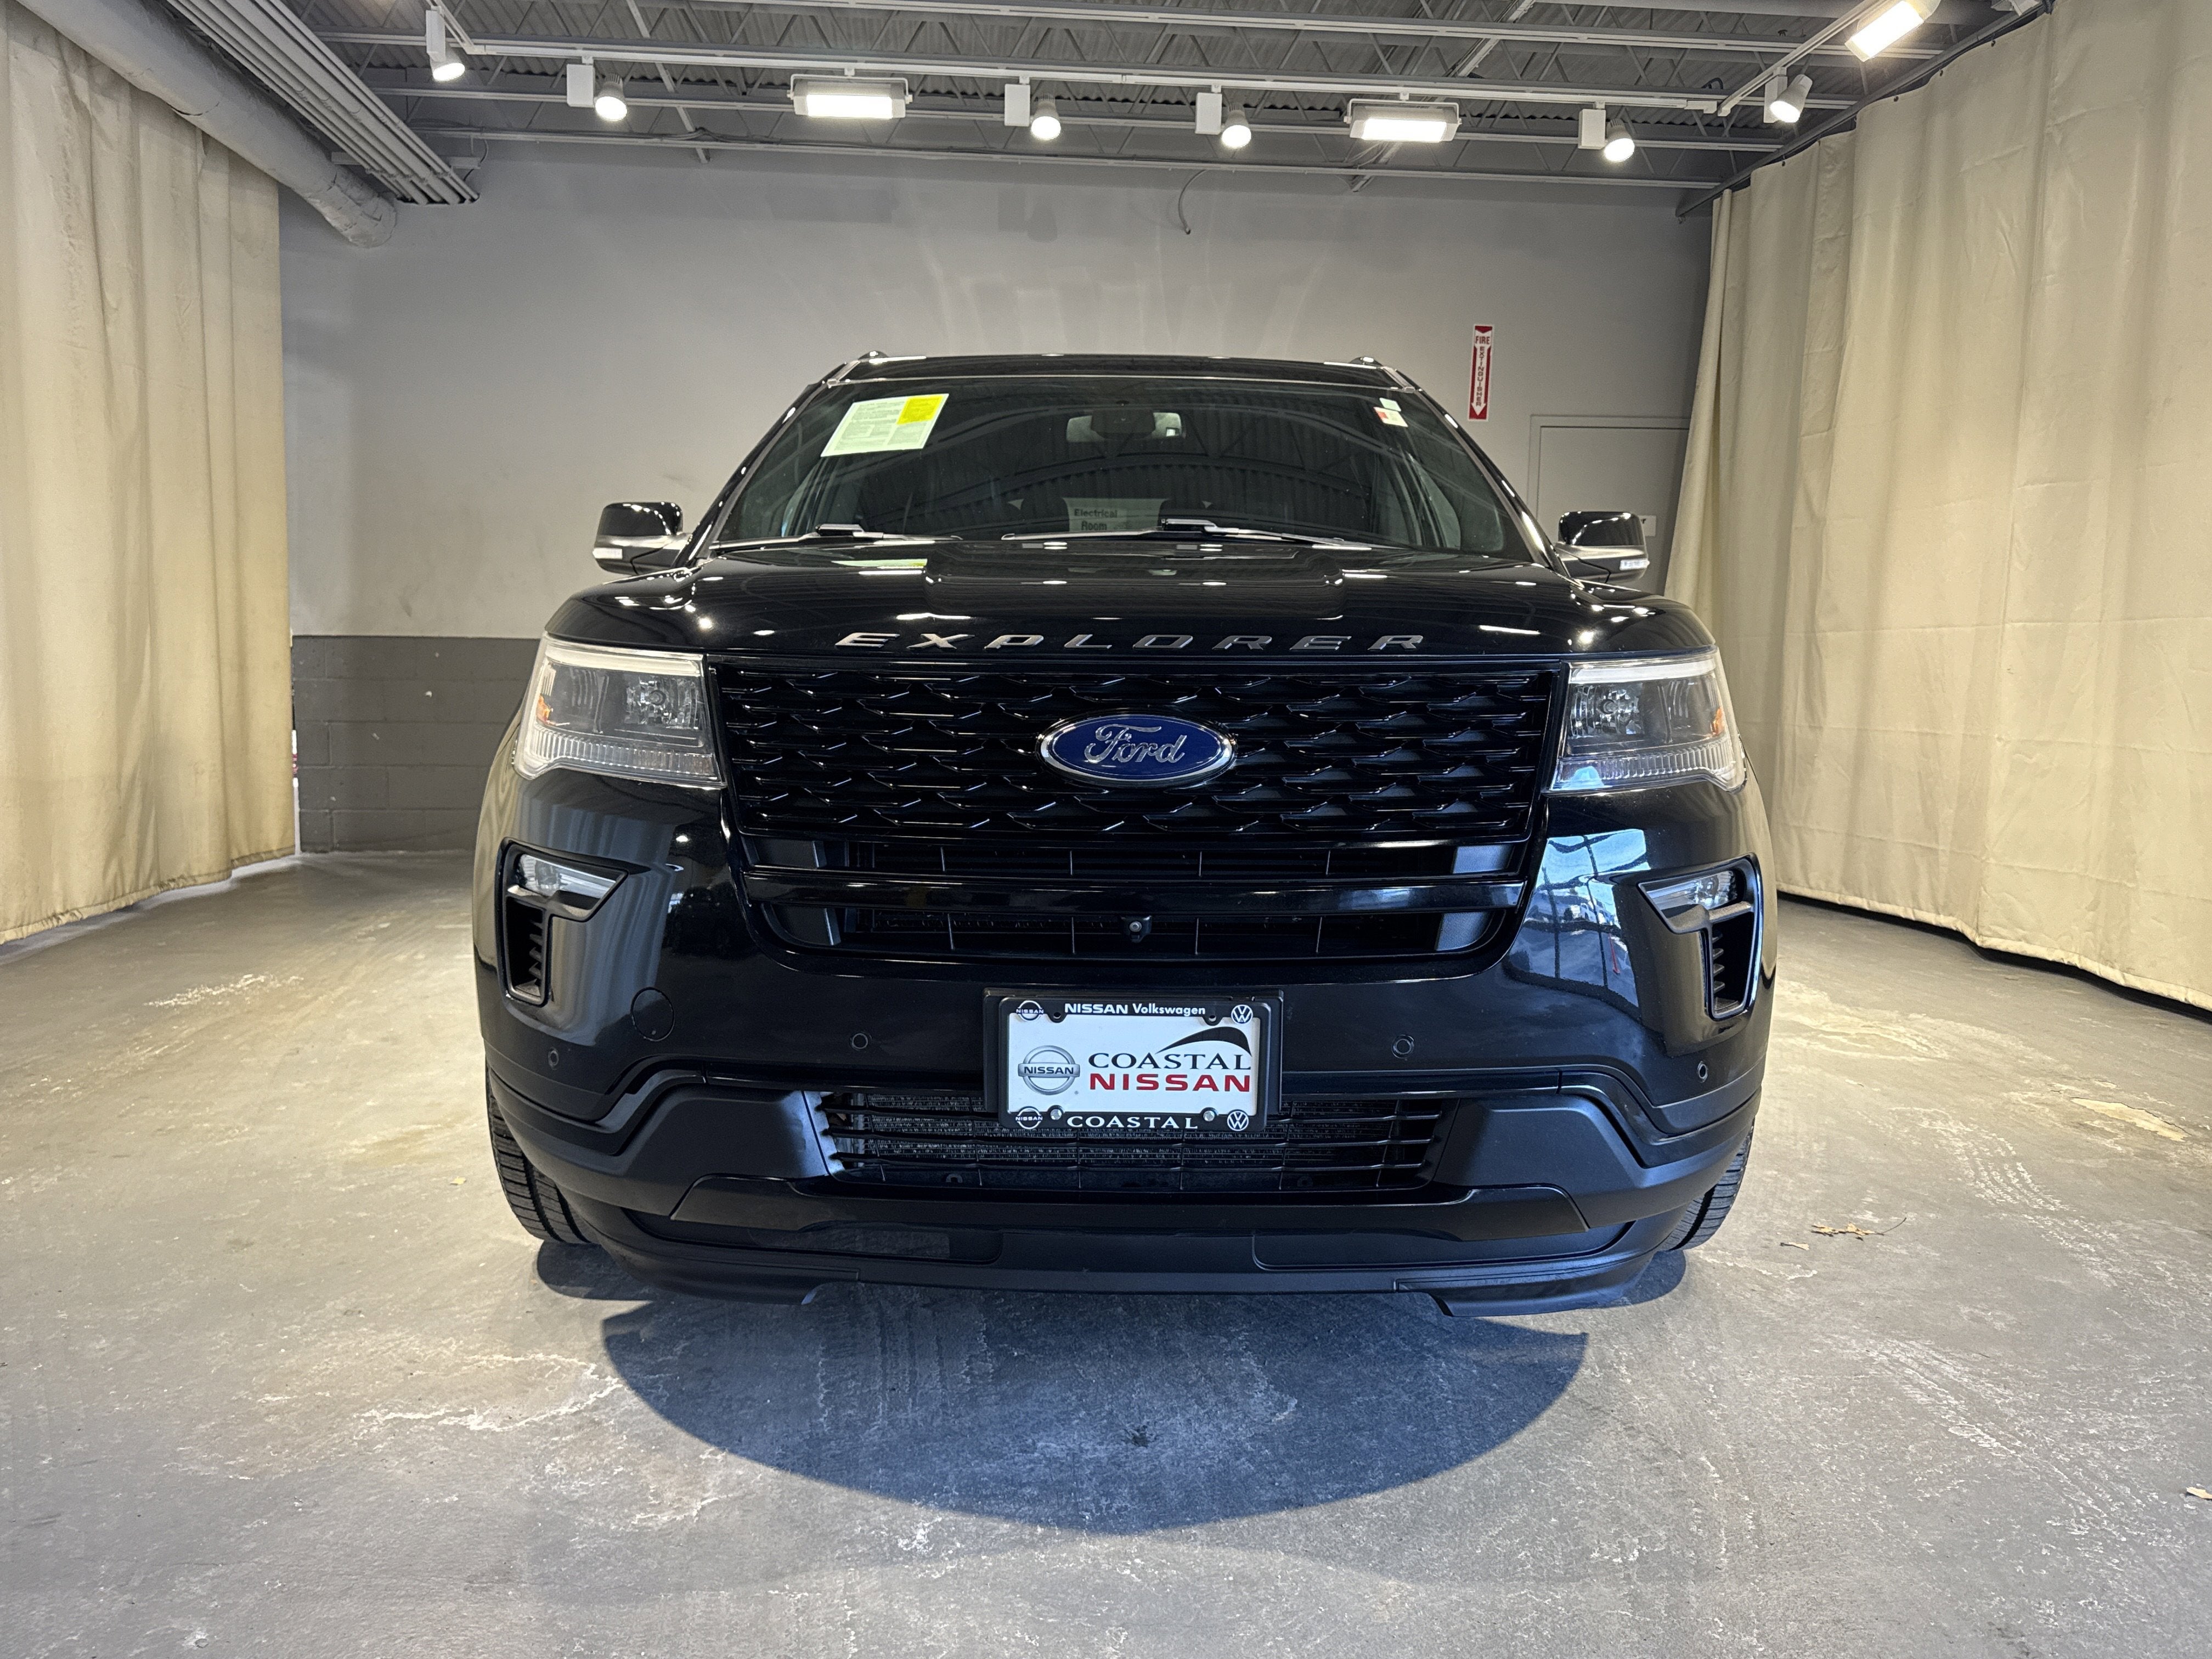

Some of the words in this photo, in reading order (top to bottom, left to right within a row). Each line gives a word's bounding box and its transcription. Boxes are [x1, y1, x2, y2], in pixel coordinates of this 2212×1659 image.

[1475, 336, 1490, 345] FIRE
[1476, 346, 1485, 407] EXTINGUISHER
[1074, 508, 1118, 518] Electrical
[1081, 521, 1108, 531] Room
[834, 632, 1424, 651] EXPLORER
[1084, 724, 1188, 763] Ford
[1064, 1003, 1128, 1014] NISSAN
[1132, 1003, 1206, 1016] Volkswagen
[1088, 1052, 1252, 1070] COASTAL
[1023, 1065, 1074, 1075] NISSAN
[1090, 1073, 1250, 1092] NISSAN
[1066, 1115, 1198, 1130] COASTAL
